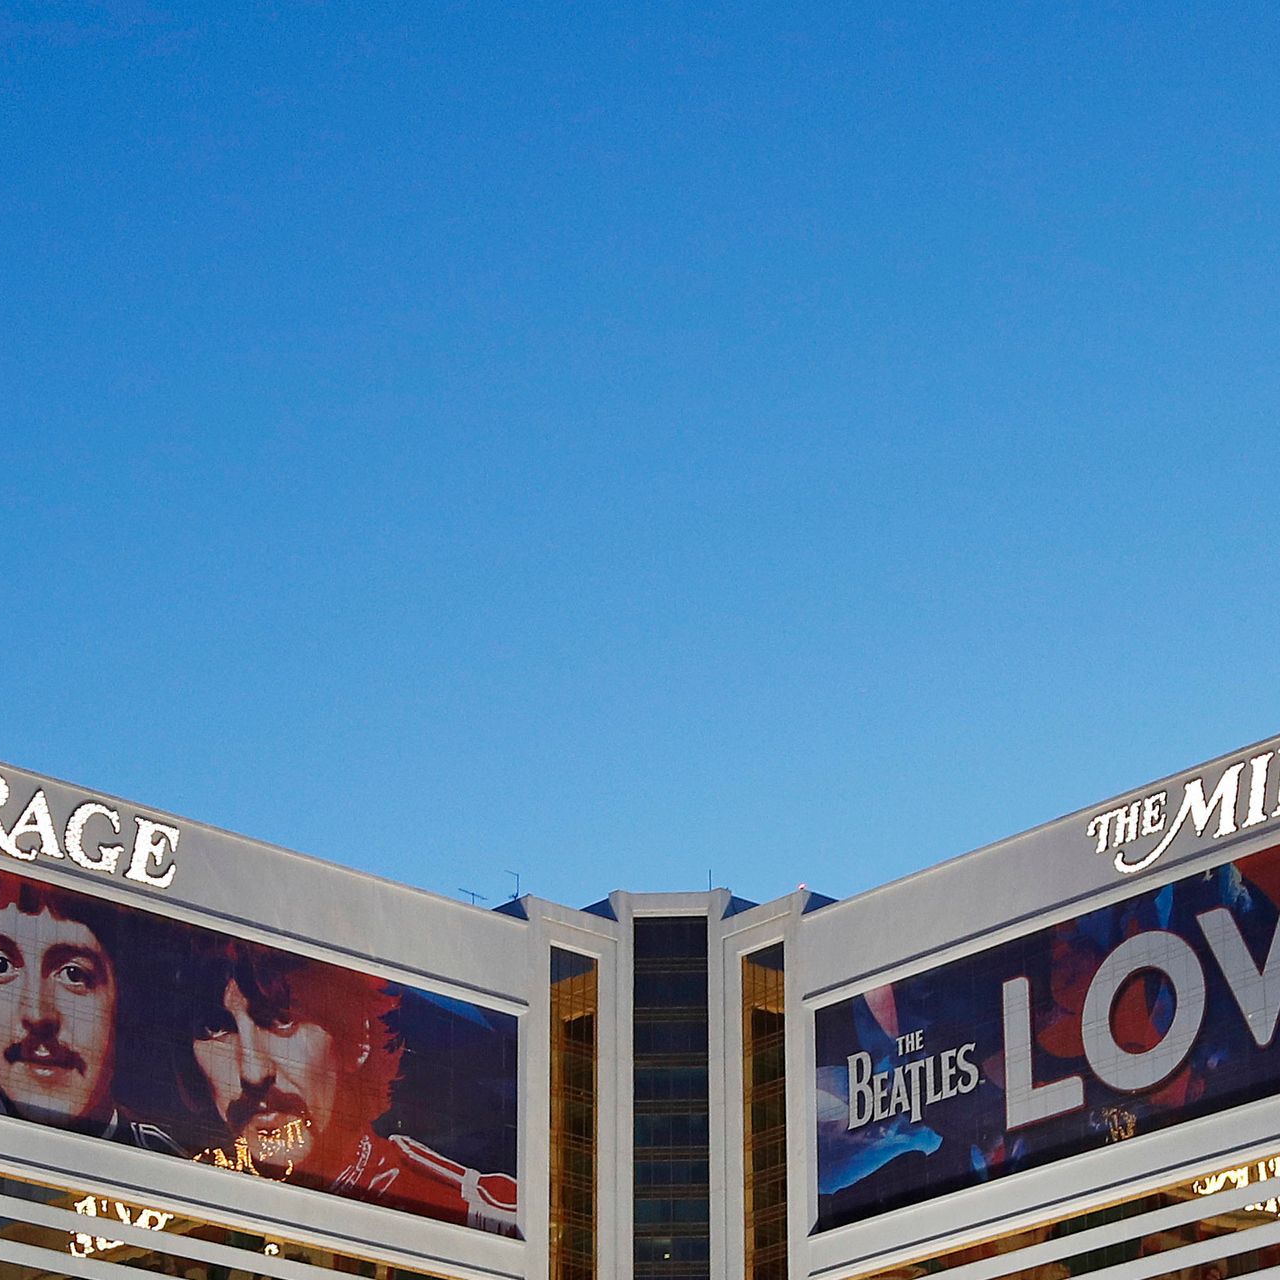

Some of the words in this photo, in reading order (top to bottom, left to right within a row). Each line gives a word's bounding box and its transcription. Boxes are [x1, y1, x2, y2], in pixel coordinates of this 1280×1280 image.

[1086, 790, 1167, 855] THE
[895, 1028, 925, 1057] THE
[846, 1041, 980, 1131] BEATLES
